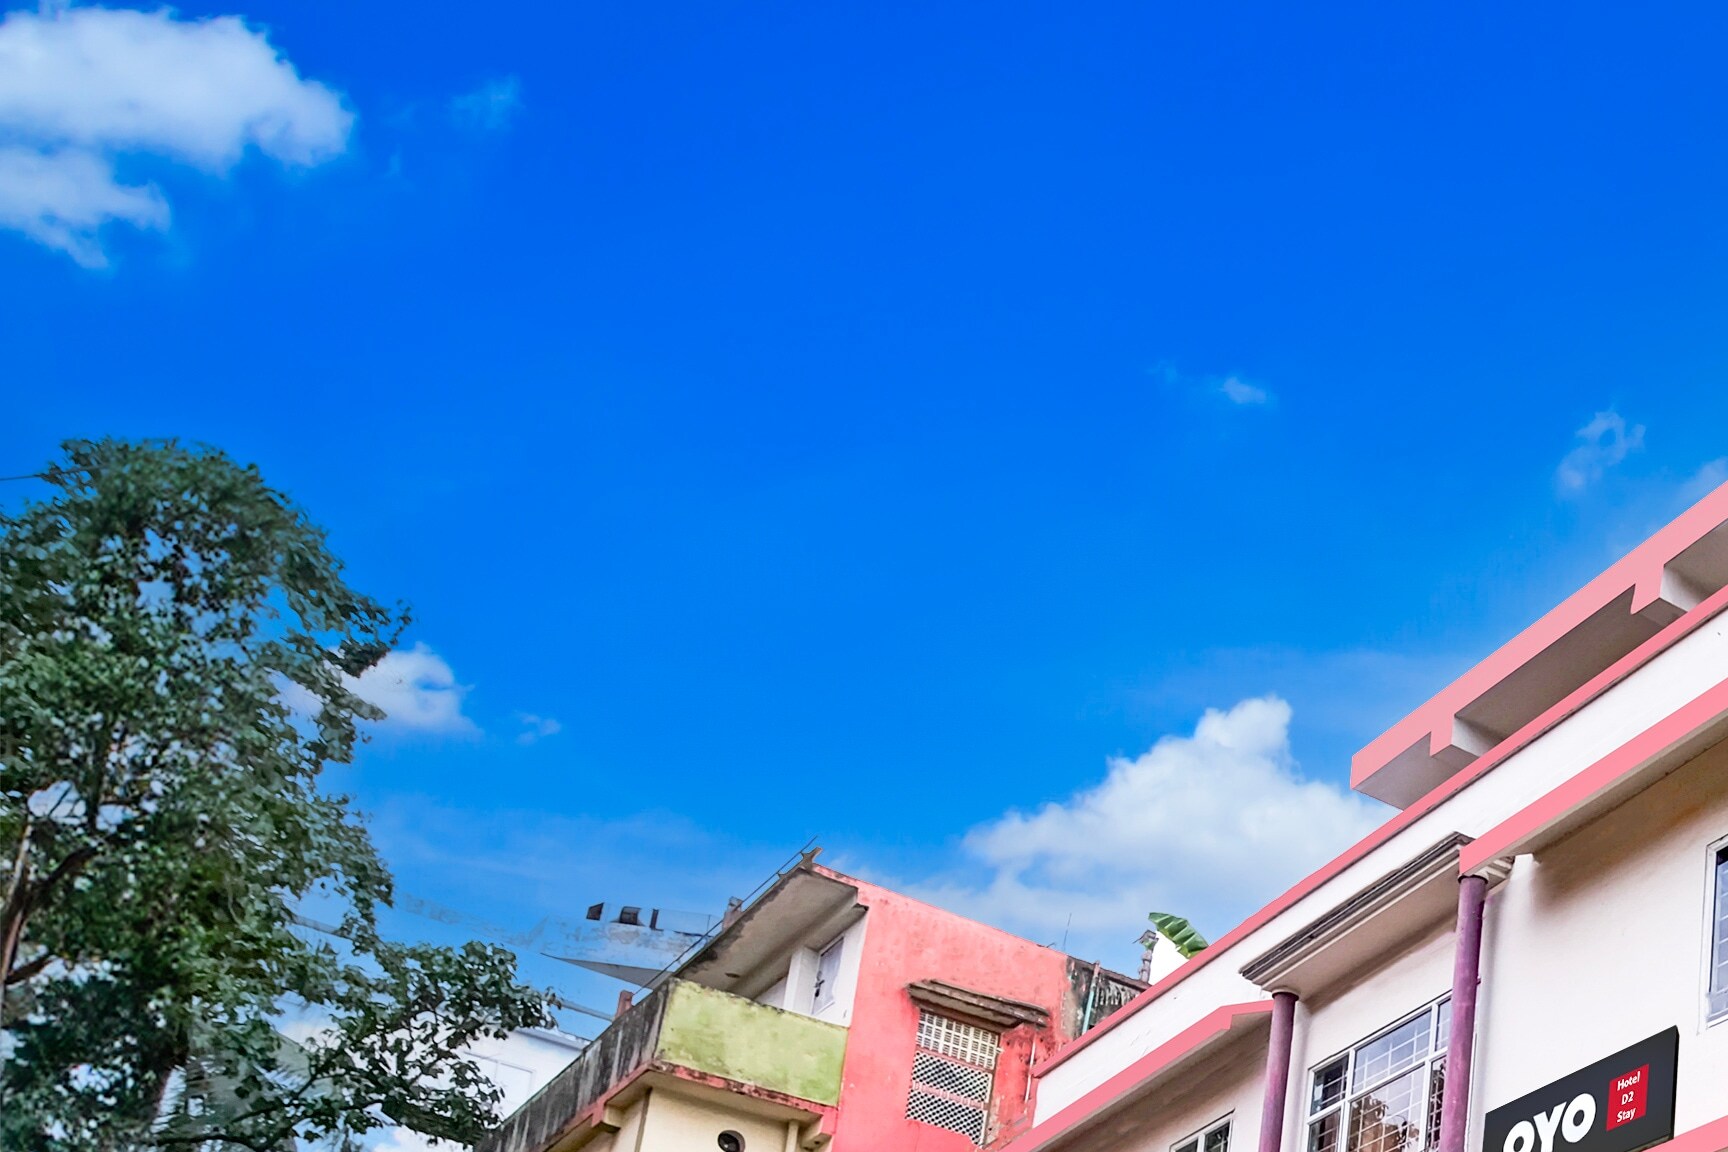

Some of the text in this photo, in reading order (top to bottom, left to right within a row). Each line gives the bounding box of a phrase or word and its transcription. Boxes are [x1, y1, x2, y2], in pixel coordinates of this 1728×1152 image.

[1617, 1070, 1641, 1091] Hotel
[1621, 1091, 1634, 1105] D2
[1616, 1107, 1637, 1123] Stay
